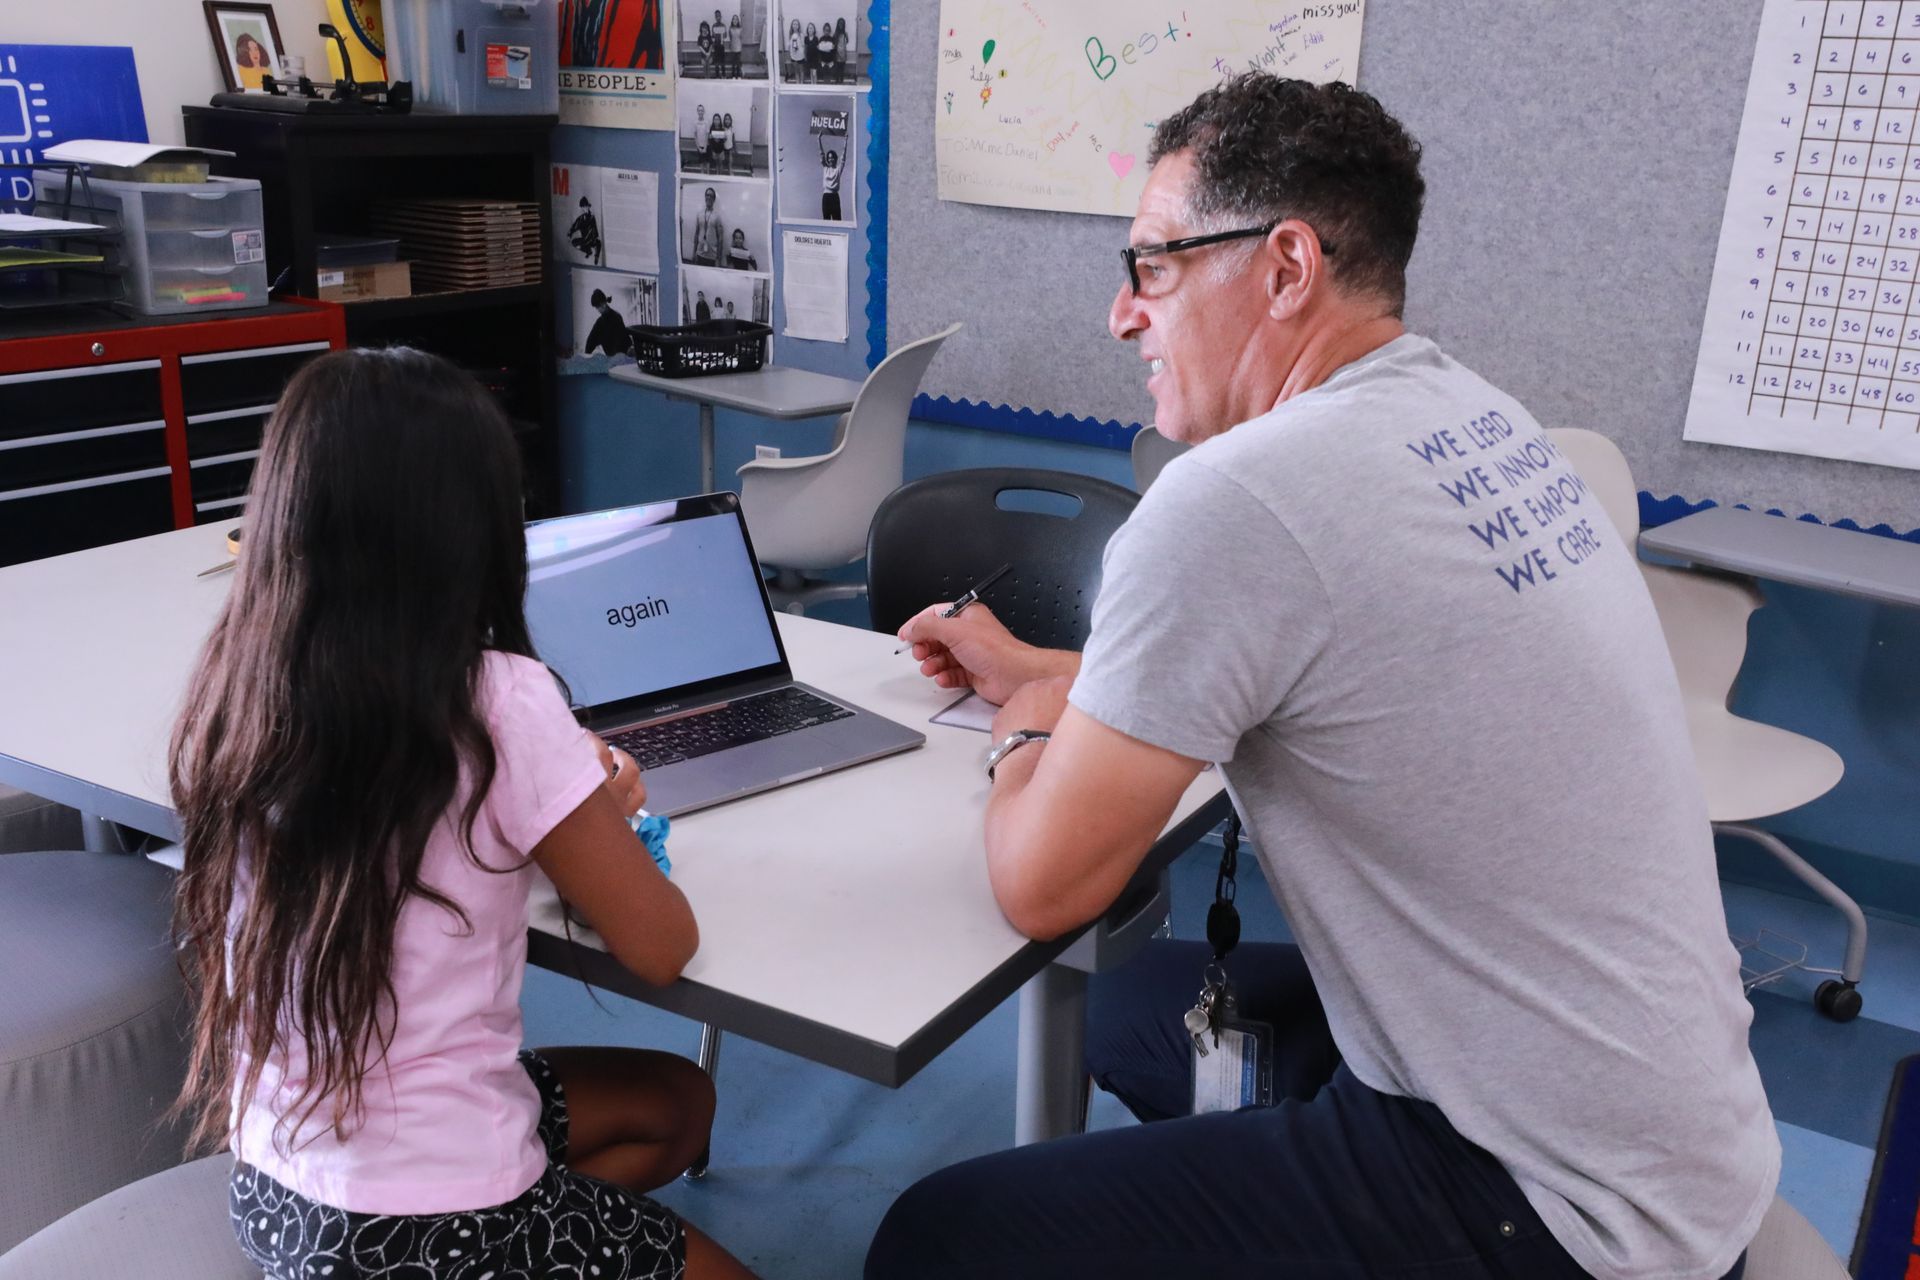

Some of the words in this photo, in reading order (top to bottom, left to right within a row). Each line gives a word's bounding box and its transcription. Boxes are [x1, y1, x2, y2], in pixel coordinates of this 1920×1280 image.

[1302, 4, 1334, 20] miss
[1875, 14, 1885, 28] 2
[1911, 14, 1920, 28] 3
[1085, 11, 1192, 81] Best!
[1792, 52, 1802, 65] 2
[1828, 51, 1839, 63] 2
[1866, 51, 1877, 64] 4
[1901, 52, 1912, 65] 6
[558, 73, 573, 88] E
[577, 73, 647, 91] PEOPLE
[1787, 82, 1797, 96] 3
[1822, 84, 1833, 98] 3
[1857, 84, 1868, 96] 6
[1897, 85, 1906, 99] 9
[810, 116, 846, 130] HUELGA
[1780, 116, 1791, 129] 4
[1816, 118, 1828, 131] 4
[1852, 119, 1863, 132] 8
[1886, 121, 1902, 134] 12
[1773, 150, 1786, 164] 5
[1809, 151, 1820, 165] 5
[1842, 154, 1858, 166] 10
[1878, 156, 1897, 170] 15
[1766, 184, 1777, 196] 6
[1802, 186, 1813, 198] 6
[1835, 190, 1851, 201] 12
[1870, 192, 1887, 204] 18
[1763, 216, 1774, 229] 7
[1796, 218, 1807, 231] 7
[1827, 221, 1844, 234] 14
[1862, 224, 1880, 237] 21
[1898, 227, 1919, 240] 28
[1756, 247, 1765, 260] 8
[1791, 250, 1801, 262] 8
[1821, 253, 1837, 265] 16
[1856, 256, 1878, 269] 24
[1889, 259, 1910, 273] 32
[1749, 277, 1760, 290] 9
[1785, 280, 1795, 293] 9
[1815, 285, 1830, 298] 18
[1847, 288, 1867, 301] 27
[1882, 291, 1903, 305] 36
[1740, 309, 1755, 321] 10
[1775, 313, 1790, 325] 10
[1809, 317, 1827, 328] 20
[1840, 319, 1861, 333] 30
[1874, 325, 1895, 338] 40
[1907, 329, 1920, 341] 5
[1736, 341, 1751, 353] 11
[1769, 345, 1783, 356] 11
[1799, 348, 1822, 360] 22
[1834, 351, 1854, 364] 33
[1867, 357, 1889, 371] 44
[1900, 361, 1920, 376] 55
[1728, 373, 1746, 385] 12
[1763, 376, 1780, 388] 12
[1793, 379, 1813, 391] 24
[1829, 383, 1847, 395] 36
[1861, 388, 1882, 400] 48
[1895, 392, 1915, 404] 60
[1406, 429, 1468, 467] WE
[1461, 410, 1513, 450] LEAD
[1437, 466, 1500, 508] WE
[1466, 506, 1529, 550] WE
[1494, 548, 1558, 594] WE
[1556, 518, 1602, 566] CARE
[606, 595, 670, 629] again
